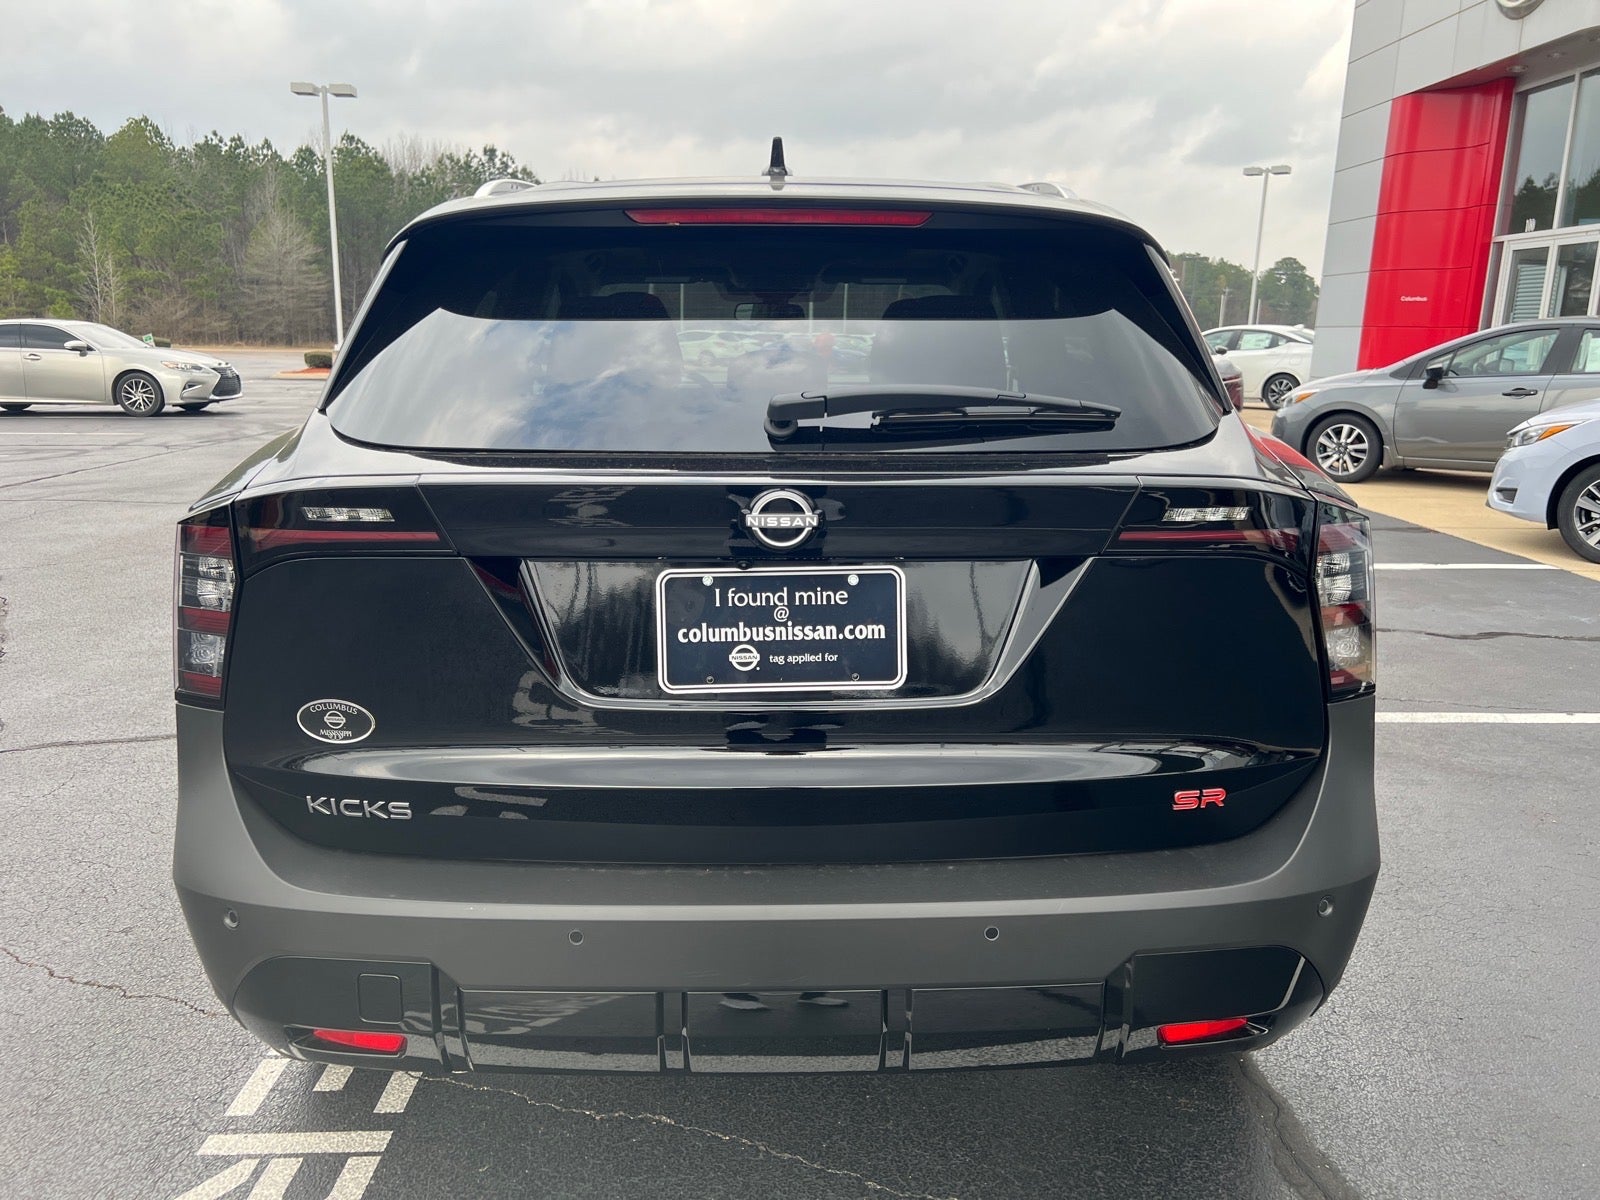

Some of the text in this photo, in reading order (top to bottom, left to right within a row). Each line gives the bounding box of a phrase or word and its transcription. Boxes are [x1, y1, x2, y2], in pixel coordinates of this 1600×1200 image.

[747, 516, 817, 527] NISSAN
[715, 587, 849, 607] I found mine
[773, 606, 790, 622] @
[677, 621, 886, 643] columbusnissan.com
[769, 652, 839, 665] tag applied for
[309, 702, 358, 715] COLUMBUS
[319, 729, 353, 740] MISSISSIPPI
[1172, 788, 1226, 810] SR
[306, 795, 413, 820] KICKS
